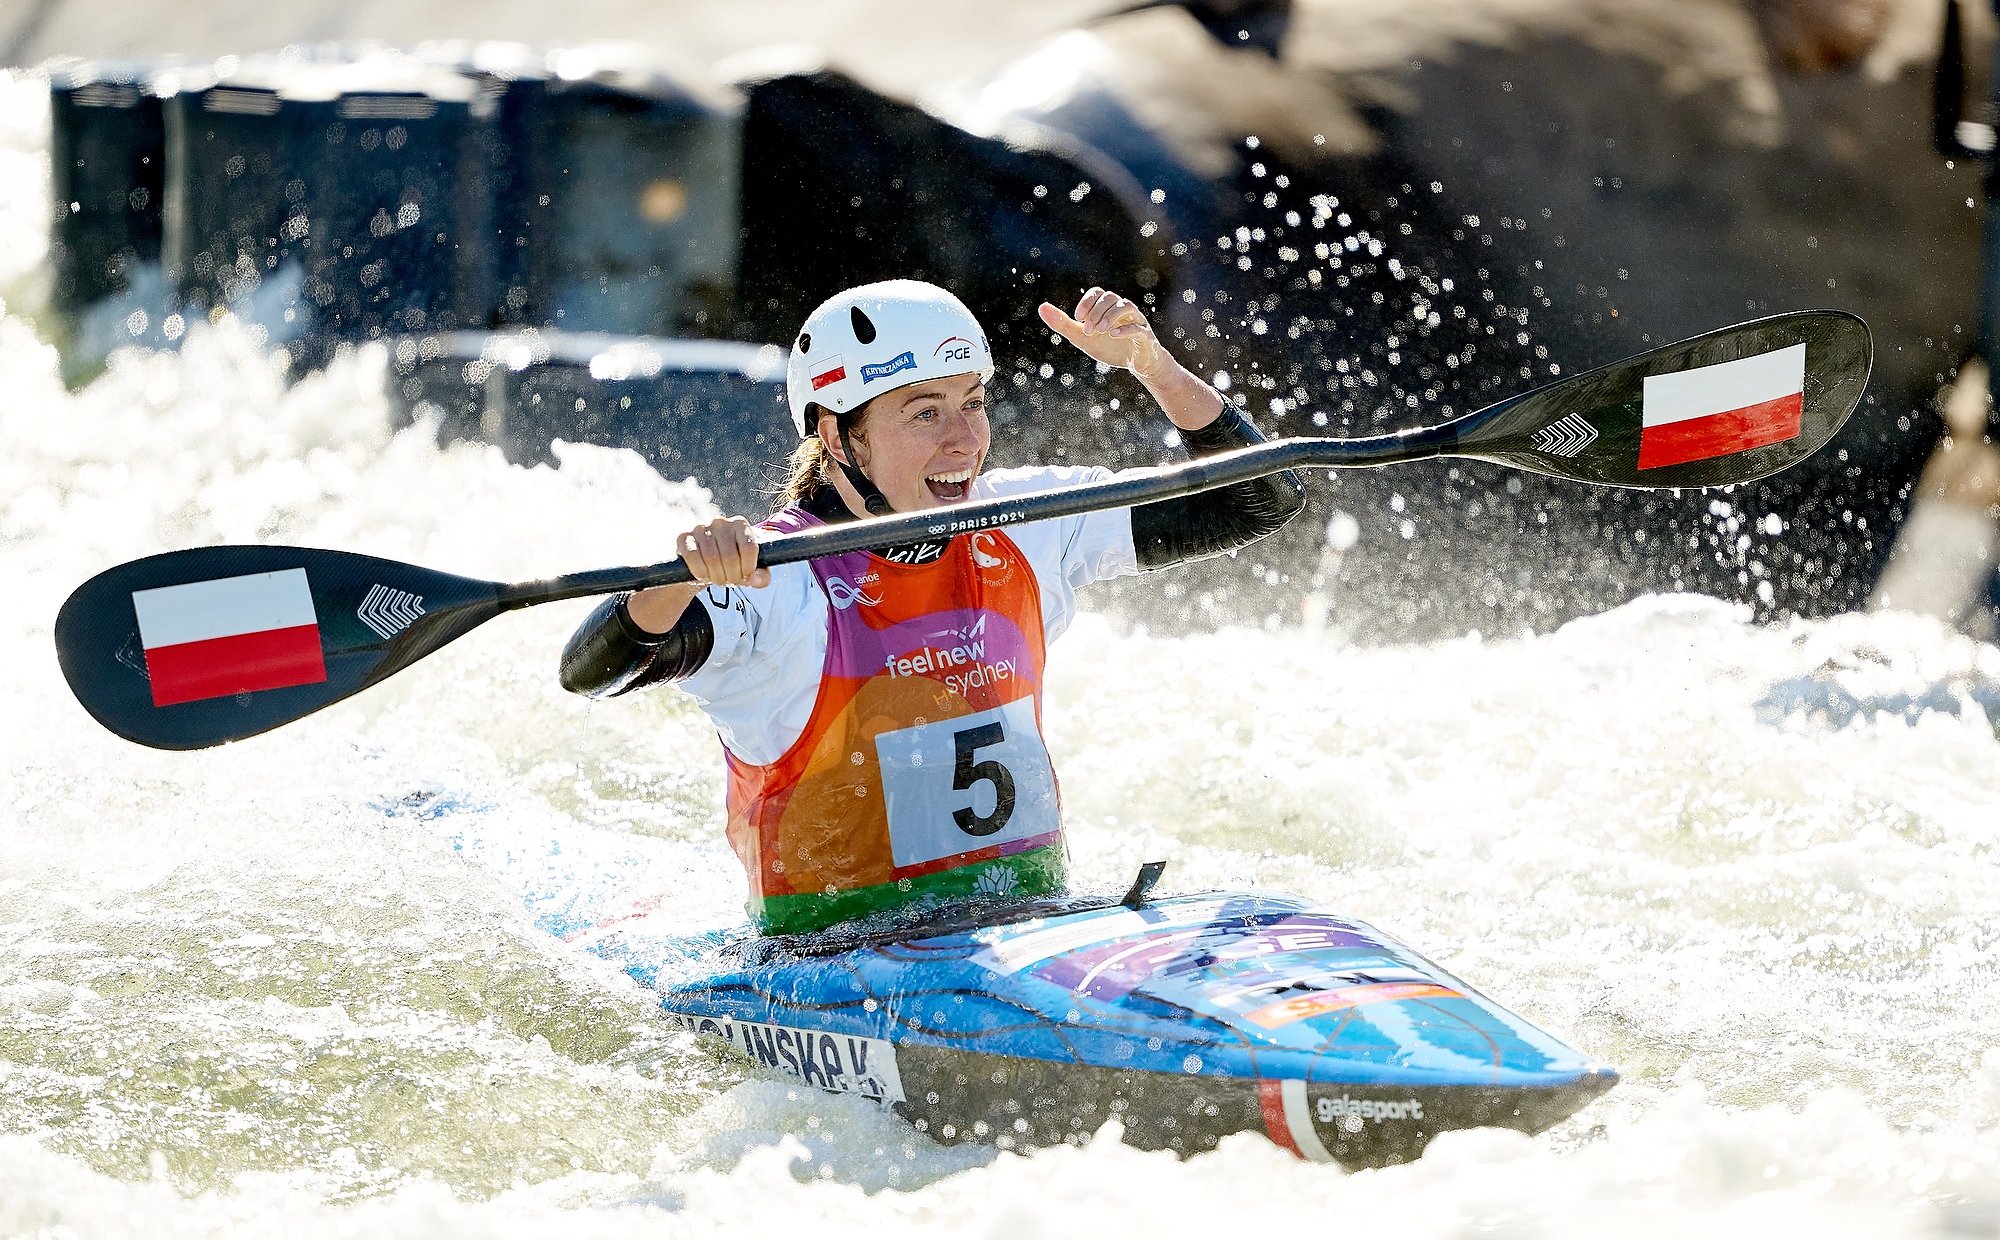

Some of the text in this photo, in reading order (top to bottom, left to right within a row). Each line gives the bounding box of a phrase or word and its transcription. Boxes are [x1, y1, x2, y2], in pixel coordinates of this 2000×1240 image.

[945, 346, 971, 363] PGE
[950, 511, 1026, 532] PARIS 2024
[885, 639, 986, 680] feel new
[944, 656, 1017, 697] sydney
[952, 721, 1016, 837] 5
[1317, 1093, 1425, 1124] galasport
